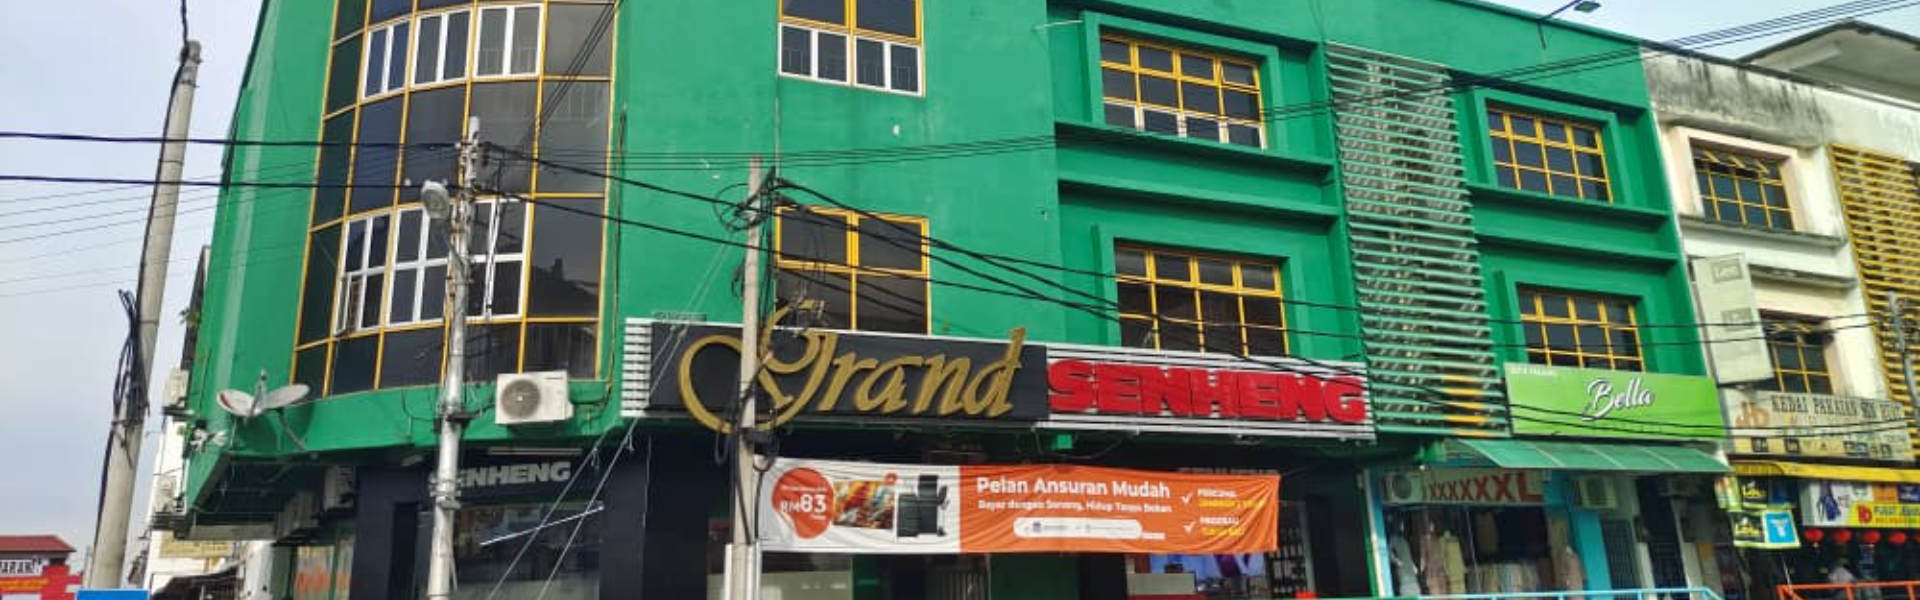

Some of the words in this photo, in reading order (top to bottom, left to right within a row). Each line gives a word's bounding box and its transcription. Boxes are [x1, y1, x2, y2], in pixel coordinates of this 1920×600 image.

[679, 298, 1026, 433] Grand
[1047, 359, 1367, 423] SENHENG
[1582, 377, 1654, 421] Bella
[457, 461, 572, 488] ENHENG
[976, 476, 1028, 494] Pelan
[1034, 478, 1108, 495] Ansuran
[1112, 480, 1170, 498] Mudah
